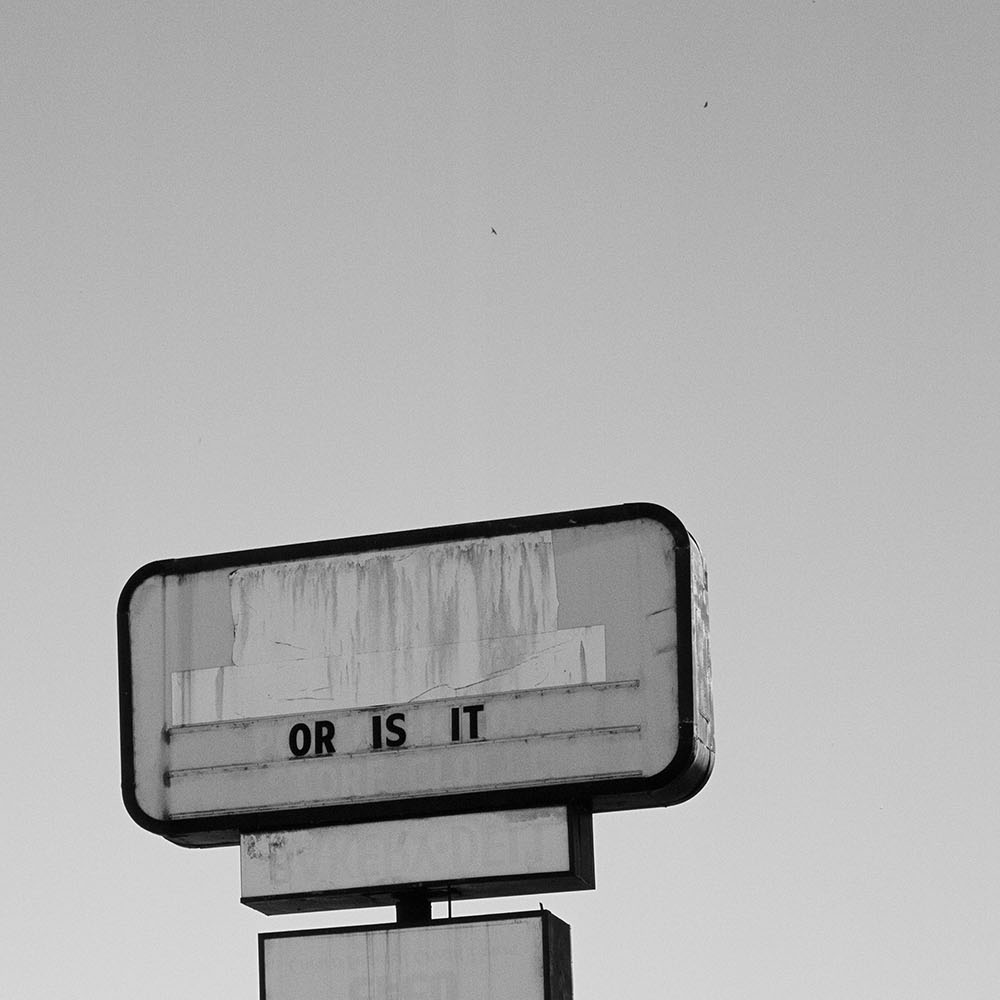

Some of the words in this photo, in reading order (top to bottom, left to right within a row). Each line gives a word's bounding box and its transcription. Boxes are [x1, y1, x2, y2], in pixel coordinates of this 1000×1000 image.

[288, 720, 336, 757] OR
[372, 713, 407, 749] IS
[451, 704, 484, 741] IT
